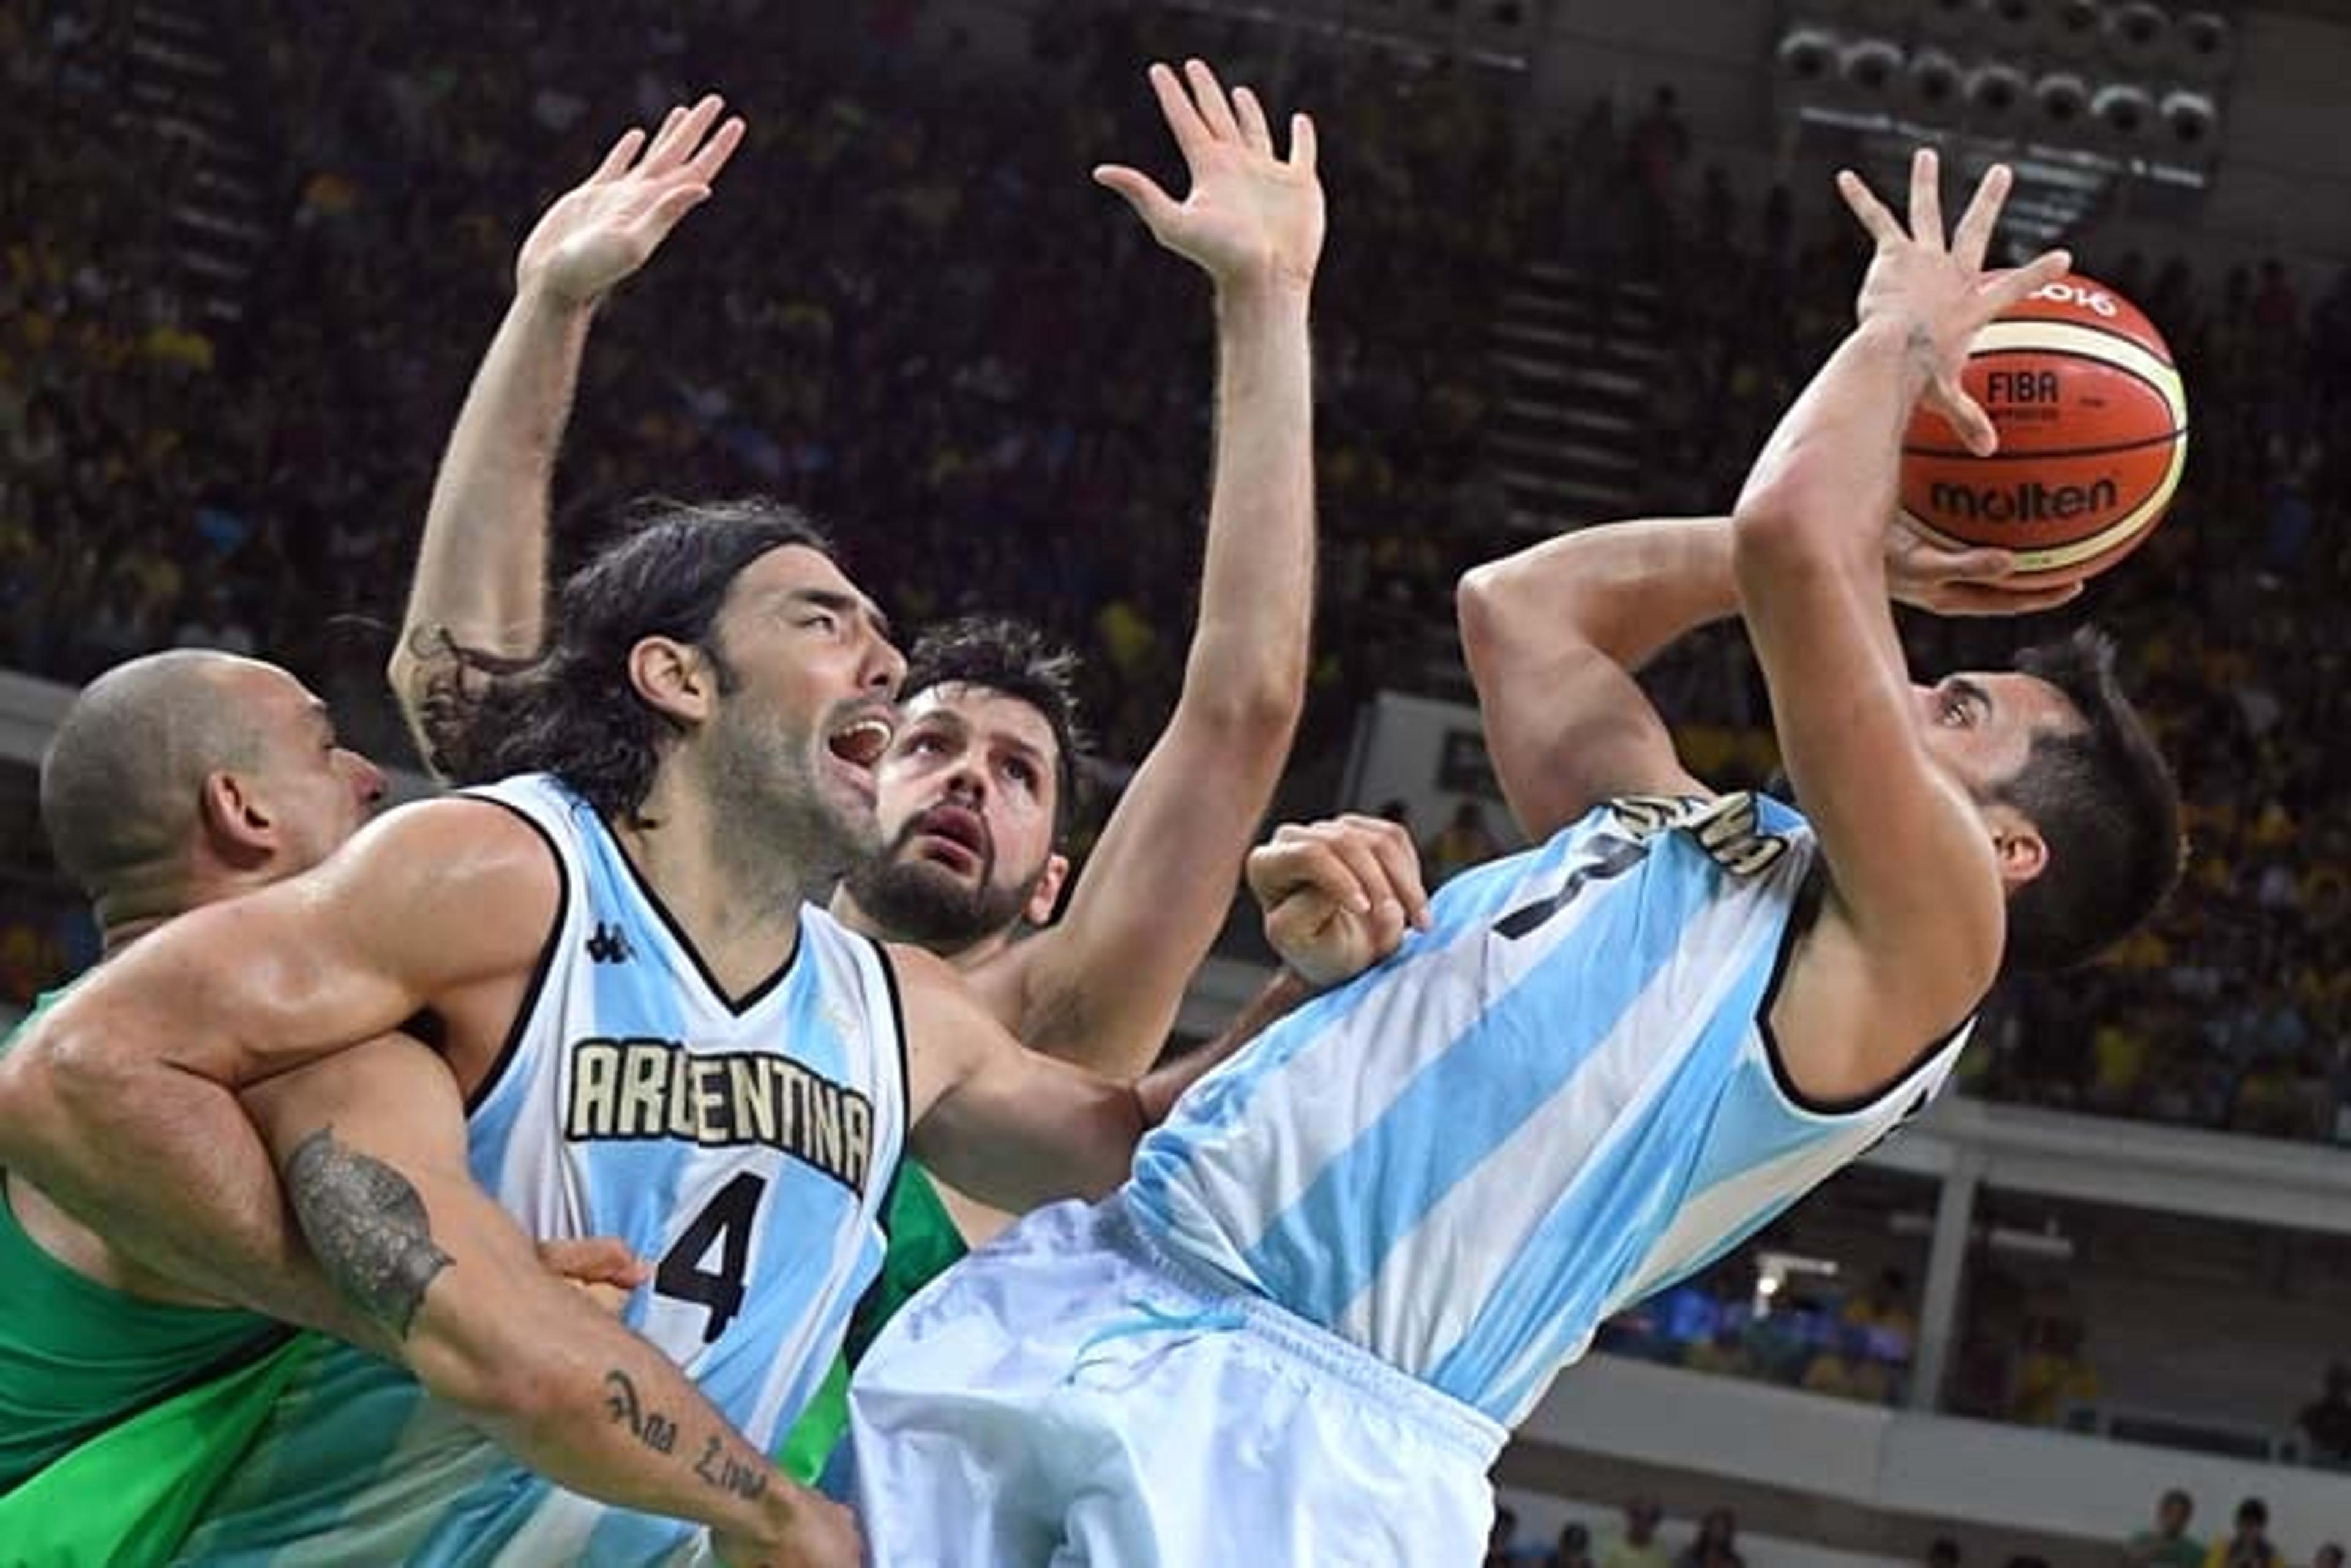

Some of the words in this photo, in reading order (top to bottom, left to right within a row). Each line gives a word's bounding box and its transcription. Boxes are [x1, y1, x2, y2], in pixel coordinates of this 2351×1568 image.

[2028, 283, 2117, 317] 016
[1988, 372, 2059, 403] FIBA
[1931, 479, 2116, 522] molten
[654, 1171, 767, 1343] 4
